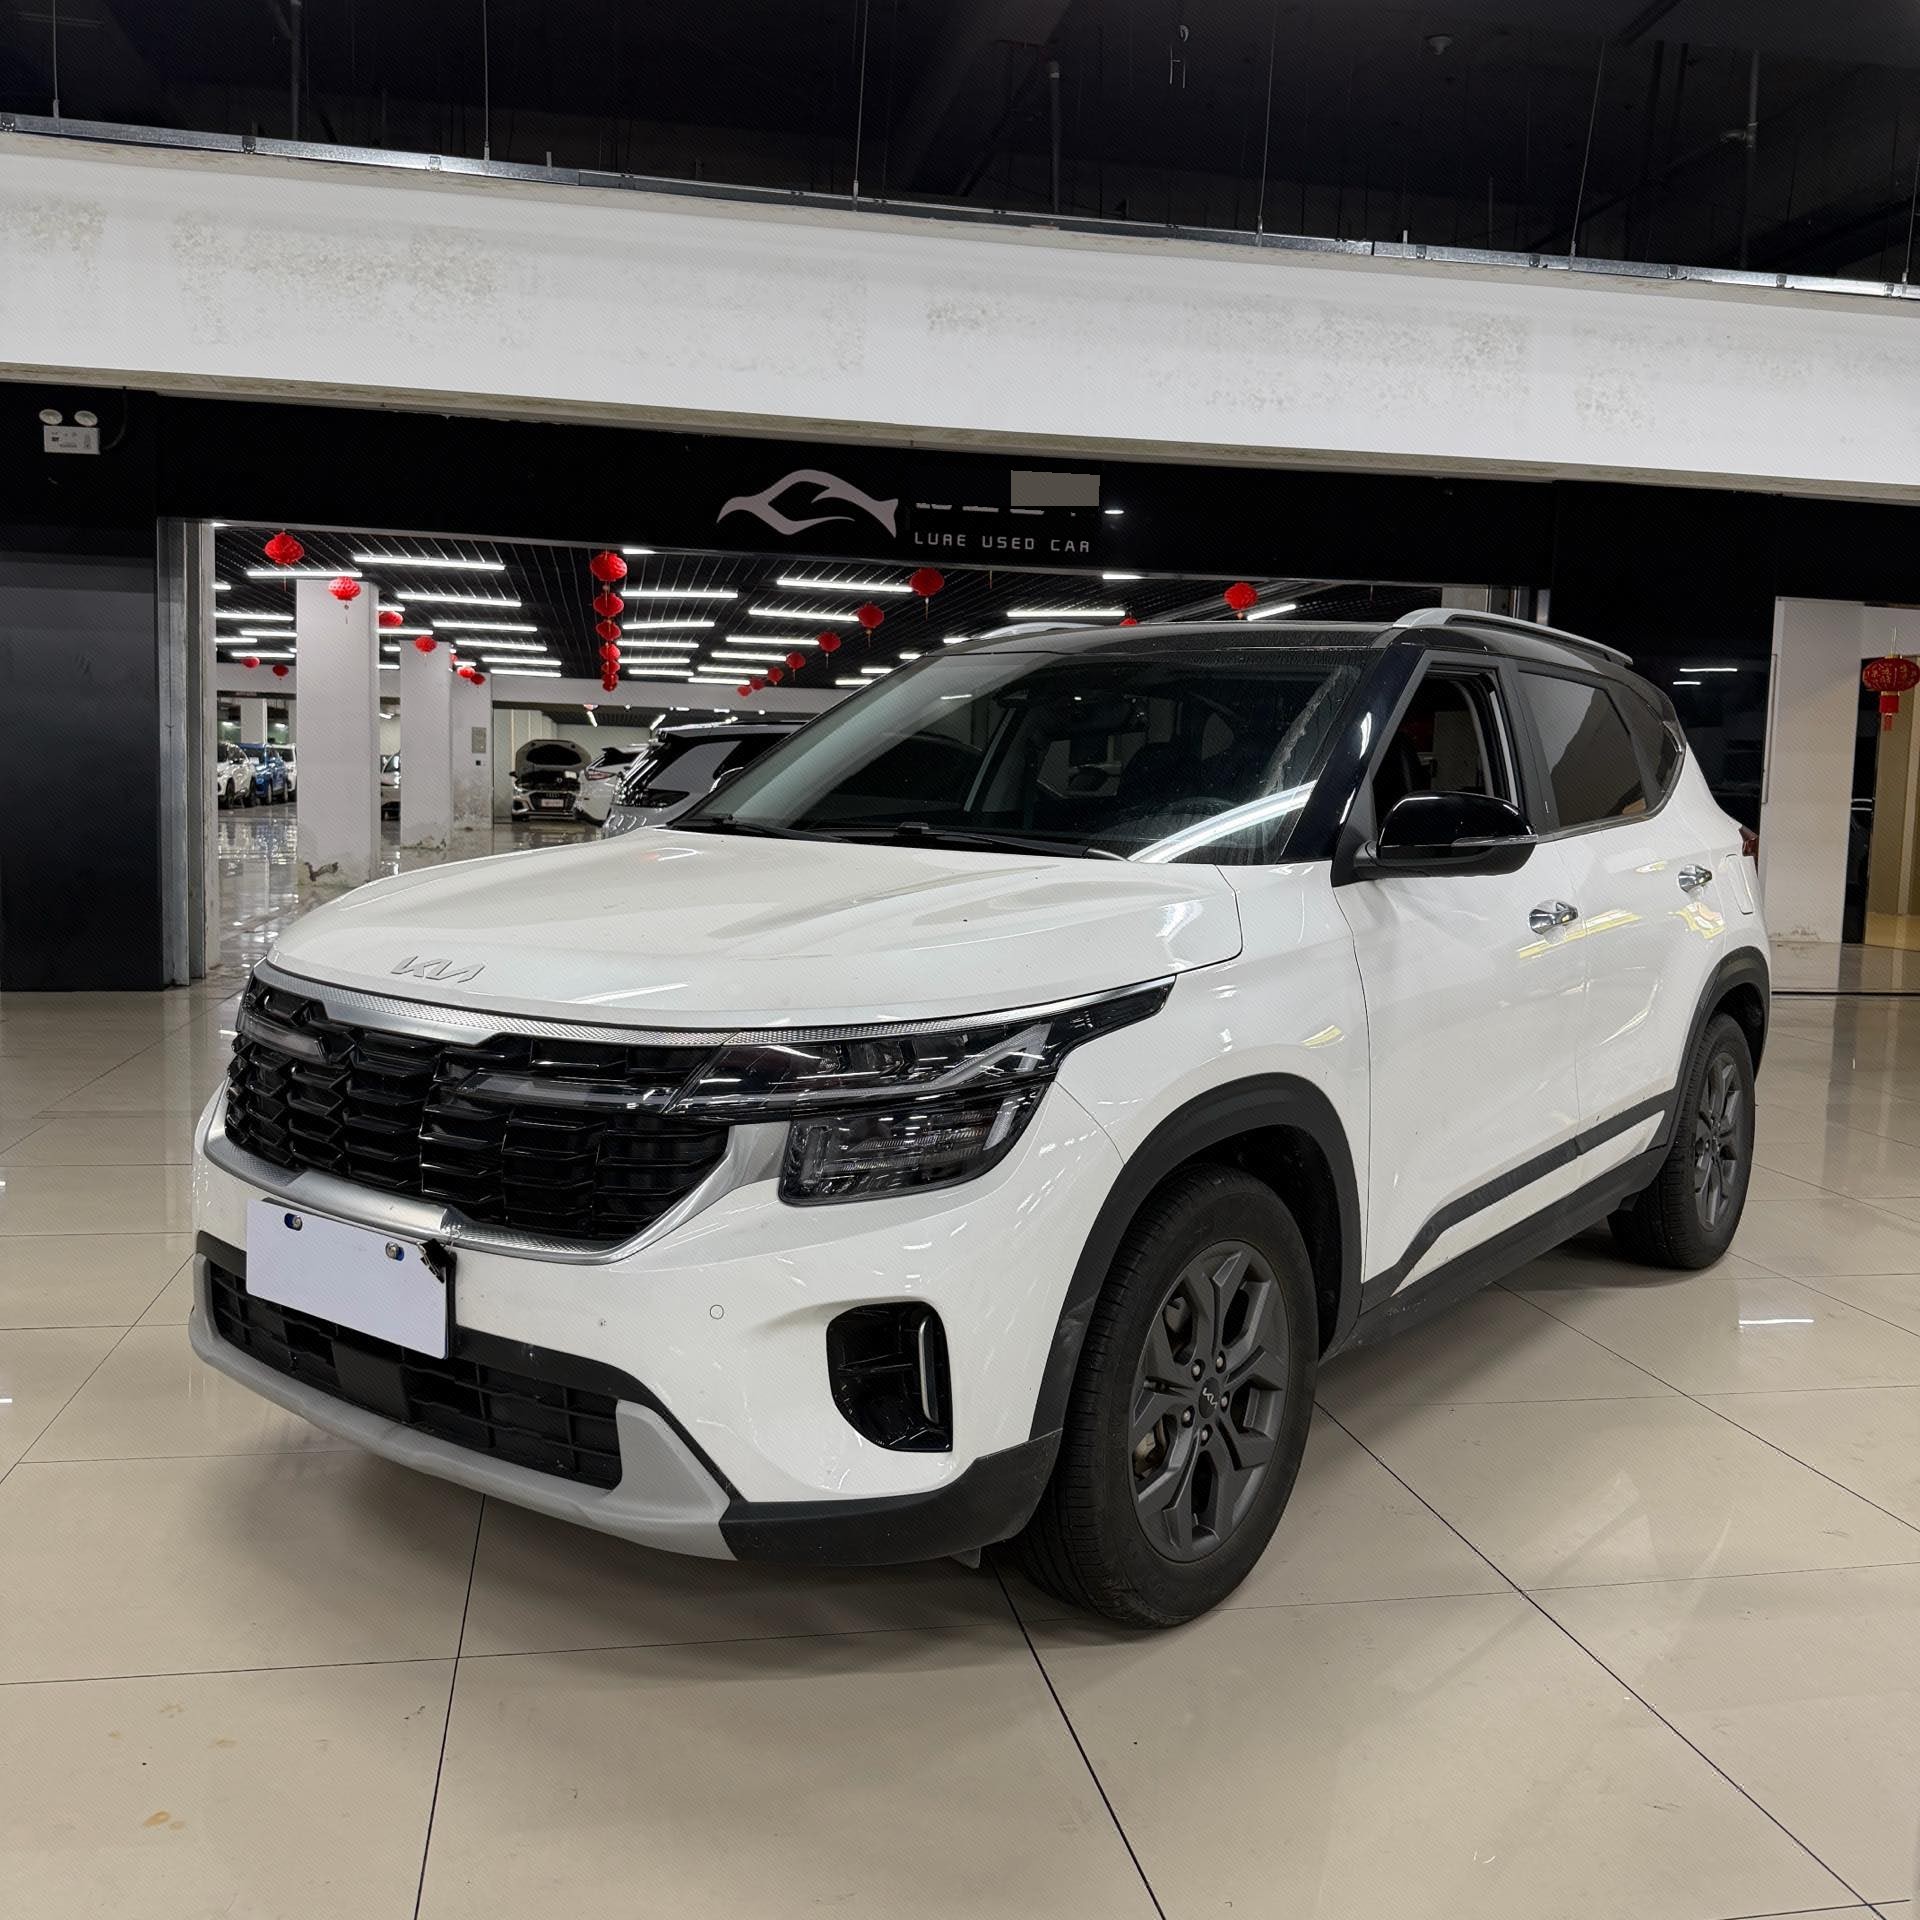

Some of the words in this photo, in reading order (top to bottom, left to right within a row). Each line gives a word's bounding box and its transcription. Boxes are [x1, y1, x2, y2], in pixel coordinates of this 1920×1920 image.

[915, 532, 966, 547] LURE
[982, 536, 1035, 550] USED
[1051, 539, 1089, 553] CAR
[391, 956, 485, 983] KIA
[1202, 1387, 1218, 1408] KIA
